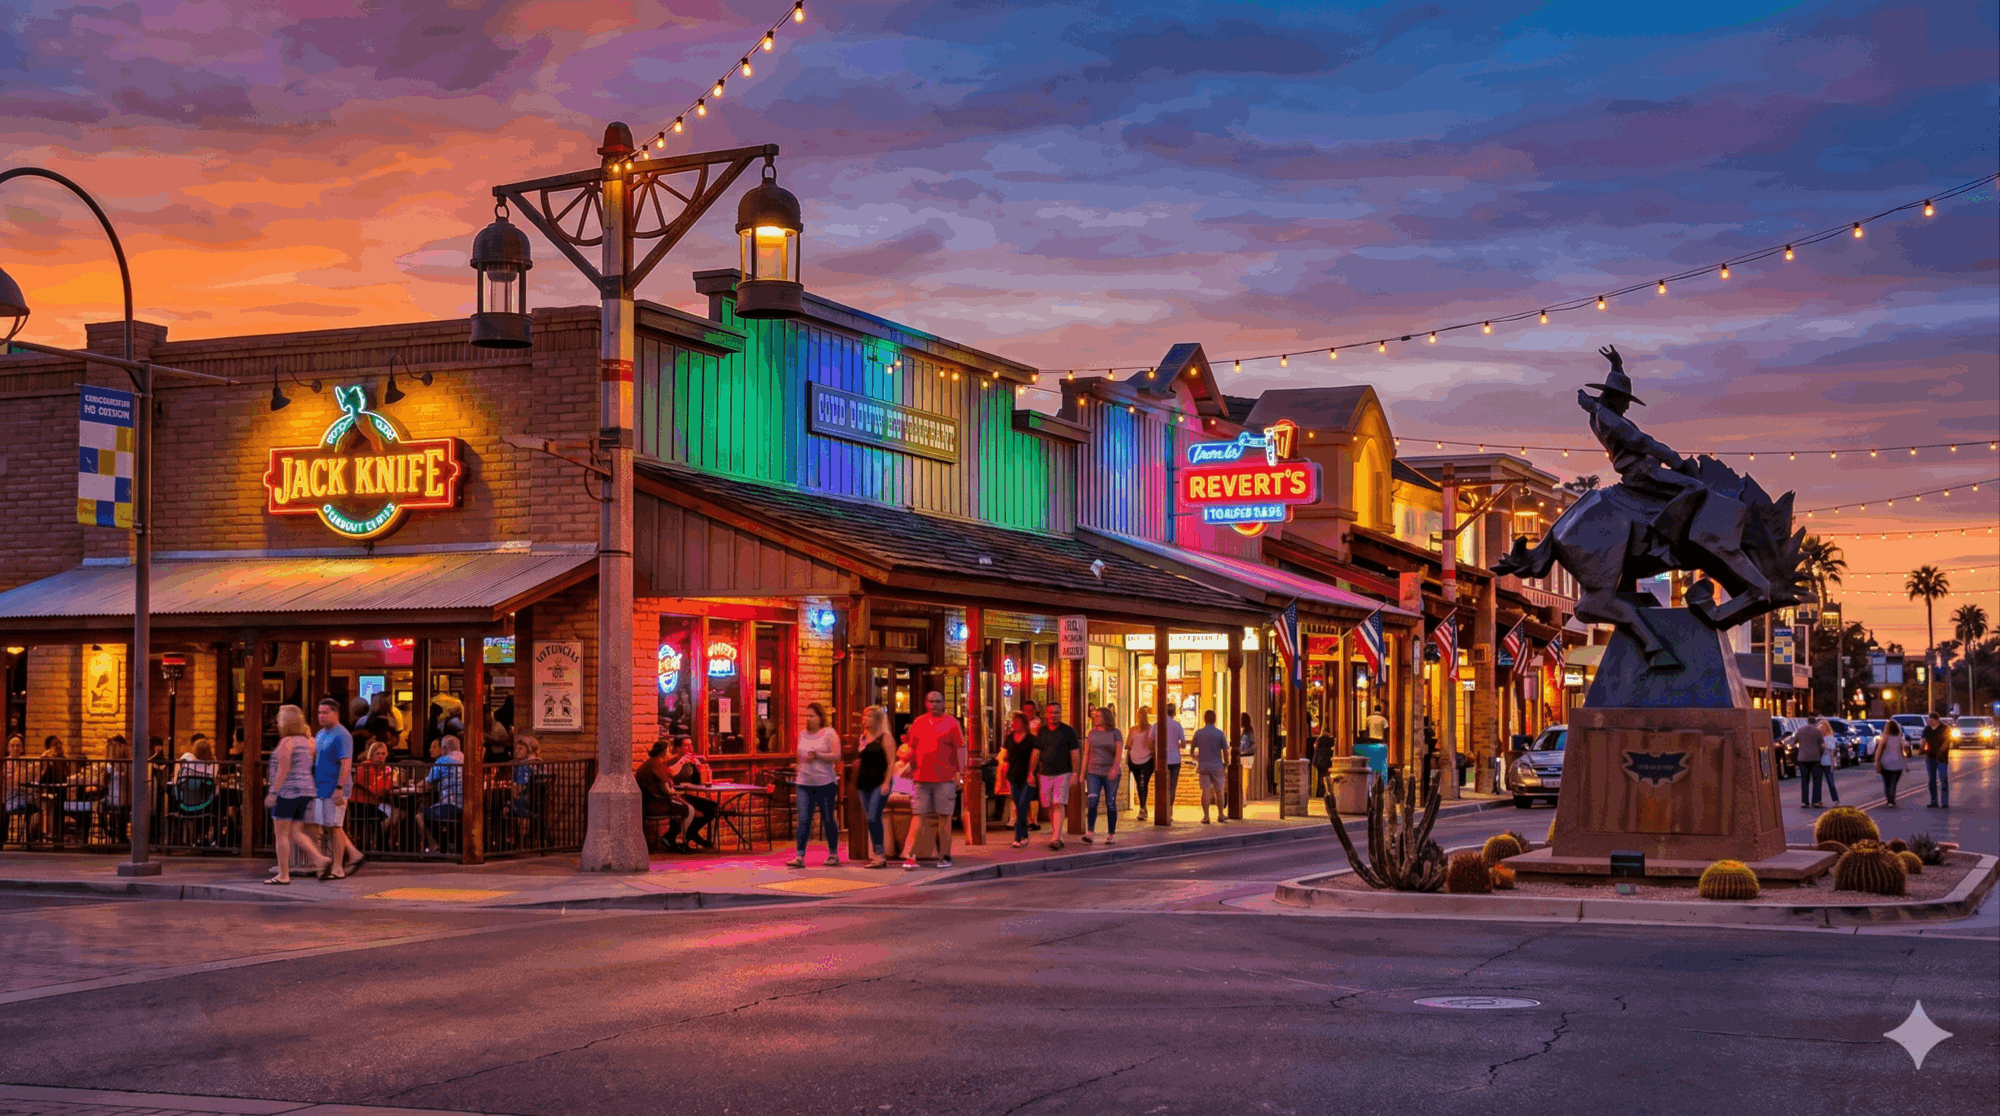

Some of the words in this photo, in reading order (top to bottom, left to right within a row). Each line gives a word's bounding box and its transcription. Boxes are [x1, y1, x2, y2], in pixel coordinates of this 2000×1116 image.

[274, 457, 348, 504] JACK
[354, 448, 445, 497] KNIFE
[1189, 468, 1306, 498] REVERT'S
